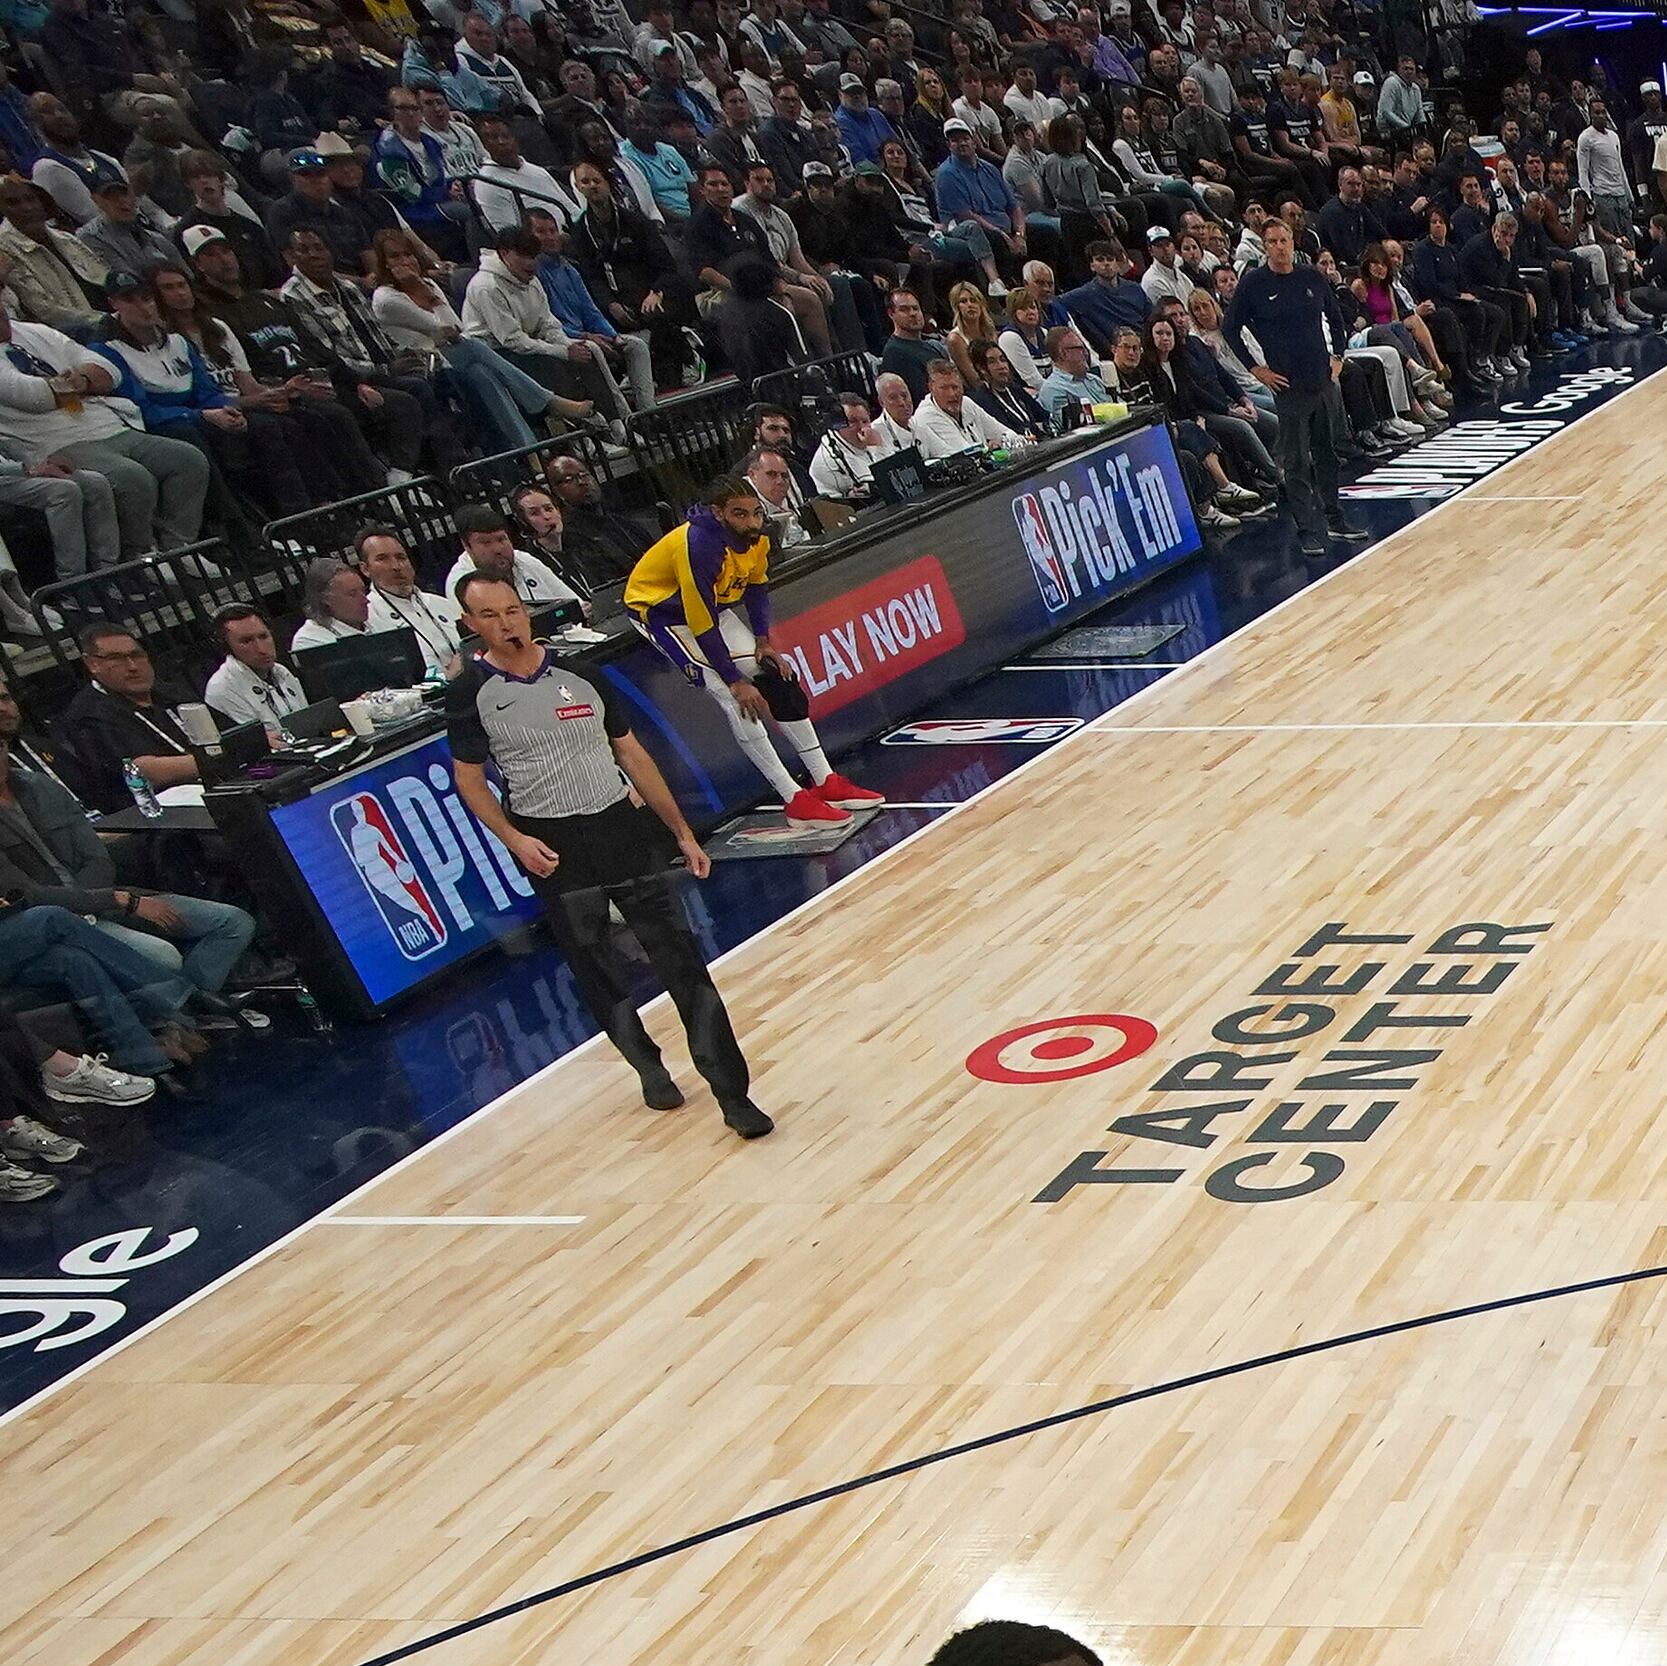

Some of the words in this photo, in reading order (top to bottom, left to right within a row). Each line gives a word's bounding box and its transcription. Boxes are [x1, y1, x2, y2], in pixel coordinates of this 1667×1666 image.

[1500, 366, 1635, 415] Google
[1354, 420, 1566, 484] PLAYOFFS
[861, 583, 943, 663] NOW
[398, 918, 430, 951] NBA
[1030, 922, 1415, 1203] TARGET
[1203, 920, 1556, 1203] CENTER
